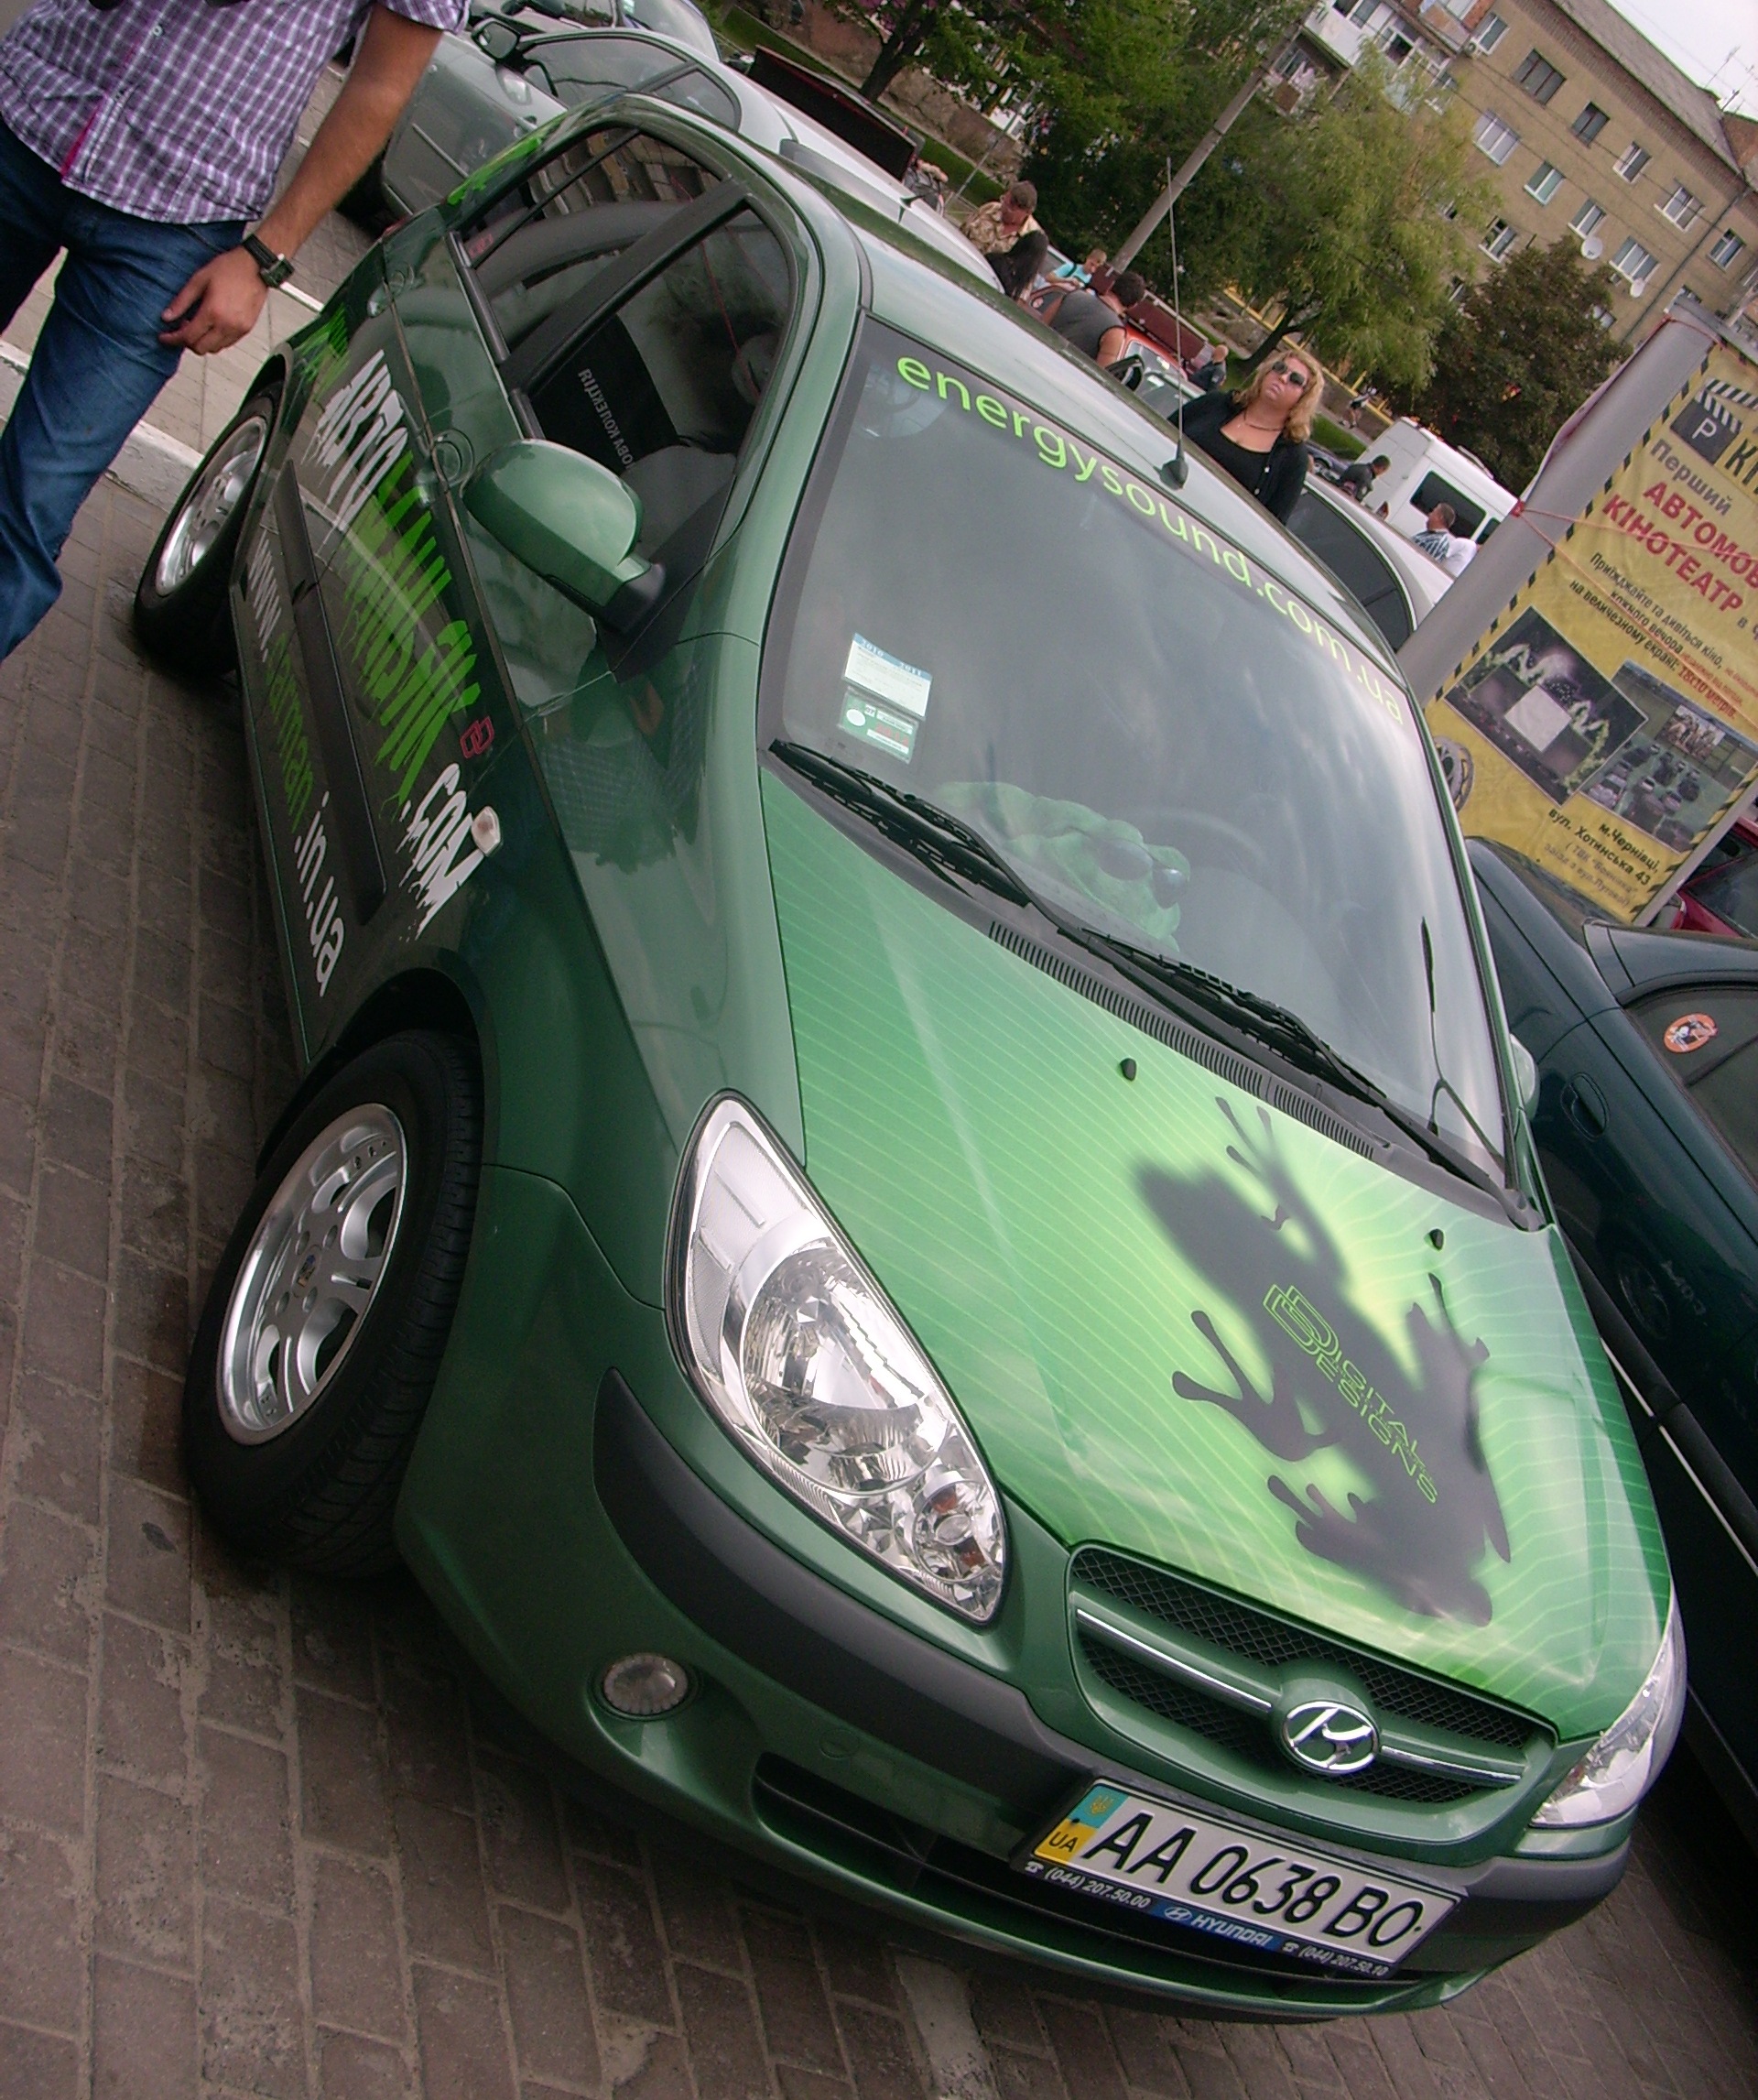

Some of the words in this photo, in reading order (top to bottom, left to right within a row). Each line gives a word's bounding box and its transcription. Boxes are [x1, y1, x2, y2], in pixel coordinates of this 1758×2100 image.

[1650, 438, 1732, 516] Перший
[896, 356, 1403, 726] energysound.com.ua
[1601, 493, 1744, 612] КІНОТЕАТР
[1569, 580, 1585, 594] на
[1583, 589, 1647, 646] величезному
[1644, 639, 1680, 671] екрані:
[1590, 551, 1653, 609] Приїжджайте
[1651, 604, 1665, 619] та
[1661, 614, 1704, 650] дивіться
[1609, 590, 1649, 627] кожного
[1647, 621, 1684, 655] вечора
[1548, 809, 1572, 831] вул.
[1574, 826, 1634, 875] Хотинська
[1635, 870, 1652, 886] 43
[1048, 1831, 1079, 1853] UA
[1080, 1810, 1199, 1885] AA
[1189, 1843, 1343, 1924] 0638
[1321, 1883, 1425, 1947] BO
[1044, 1866, 1087, 1889] (044)
[1082, 1880, 1152, 1909] 207.50.00
[1190, 1914, 1274, 1947] HYUNDAI
[1298, 1945, 1334, 1964] (044)
